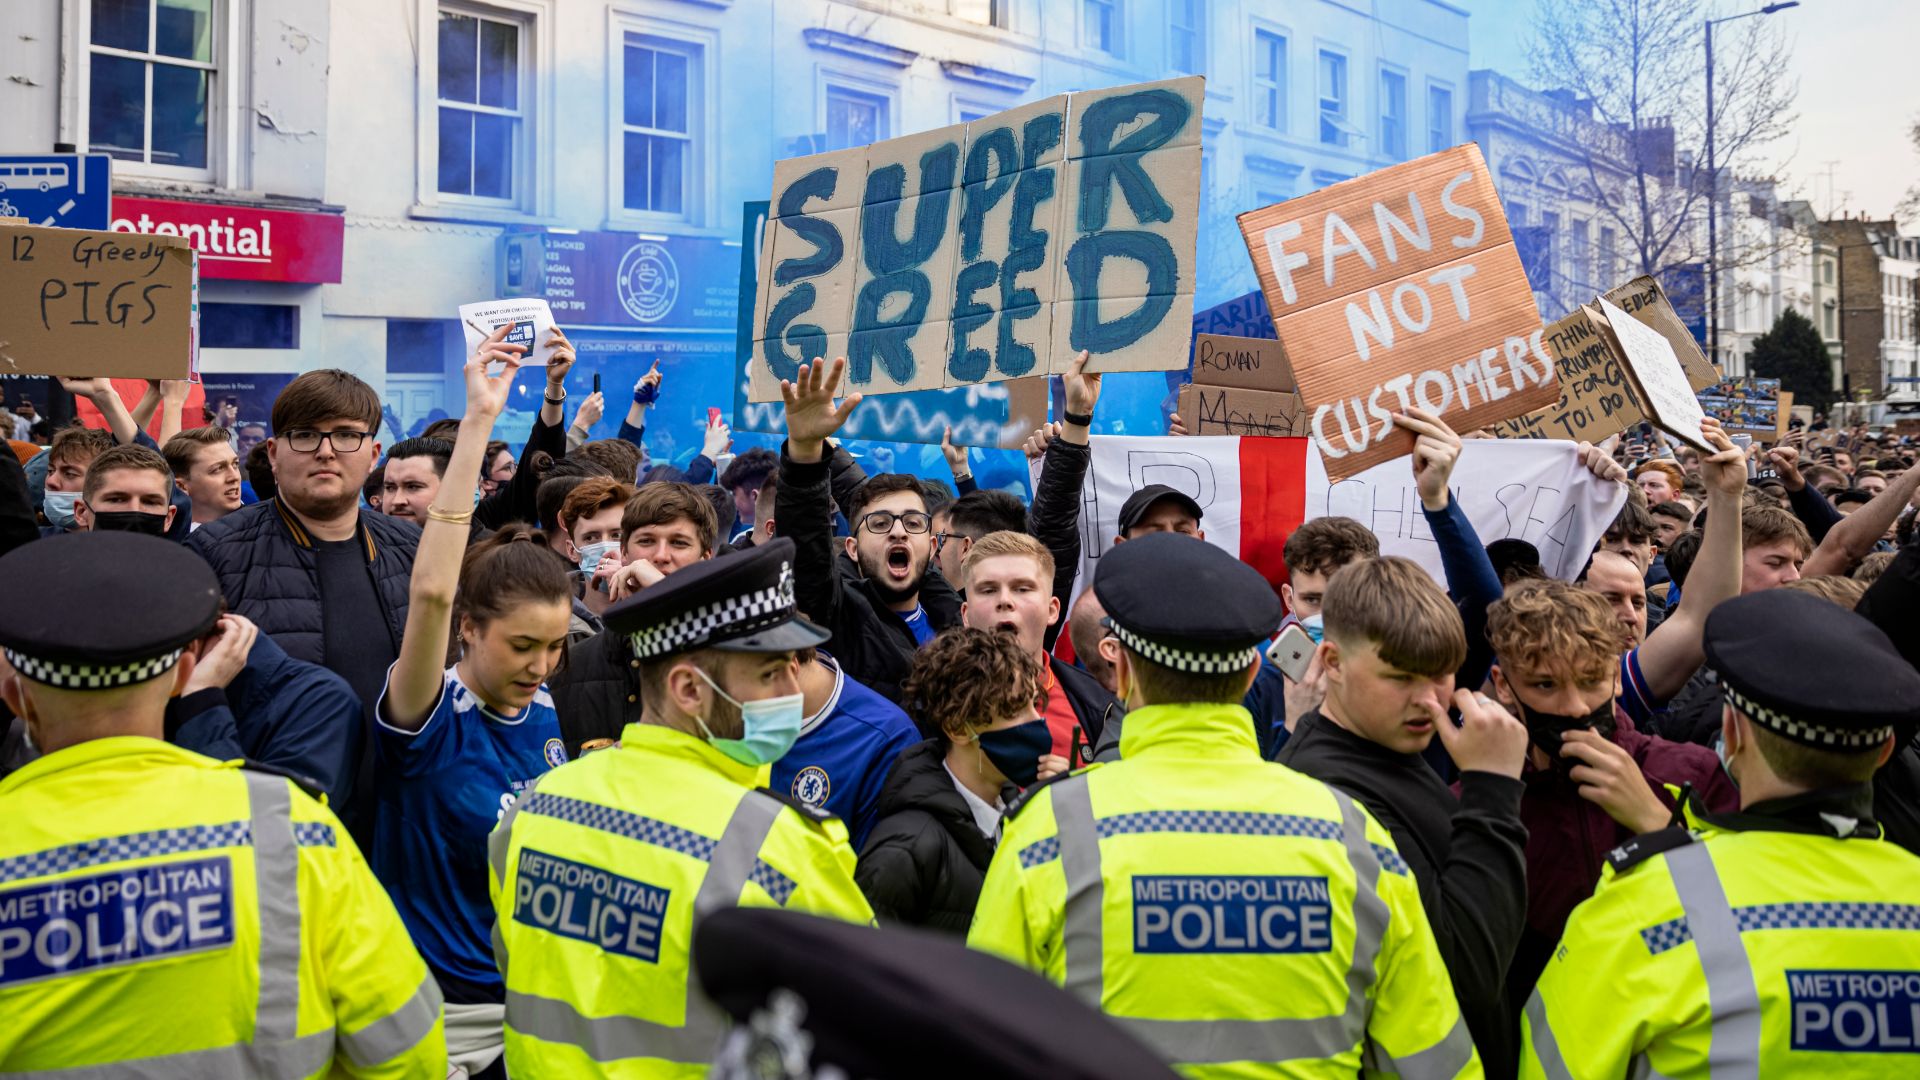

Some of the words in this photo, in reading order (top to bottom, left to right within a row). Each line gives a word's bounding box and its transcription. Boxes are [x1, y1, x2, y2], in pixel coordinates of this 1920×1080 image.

[775, 88, 1191, 287] SUPER
[13, 235, 35, 261] 12
[73, 236, 166, 278] Greedy
[1264, 172, 1485, 305] FANS
[40, 278, 172, 331] PIGS
[551, 276, 575, 286] FOOD
[551, 300, 569, 310] AND
[763, 229, 1180, 386] GREED
[509, 333, 524, 341] SAVE
[1344, 263, 1476, 362] NOT
[1201, 340, 1260, 373] ROMAN
[1311, 328, 1555, 459] CUSTOMERS
[1327, 480, 1576, 577] CHESEA
[0, 865, 221, 922] METROPOLITAN
[519, 852, 666, 915] METROPOLITAN
[1135, 879, 1330, 902] METROPOLITAN
[0, 893, 225, 977] POLICE
[515, 876, 660, 959] POLICE
[1136, 904, 1330, 949] POLICE
